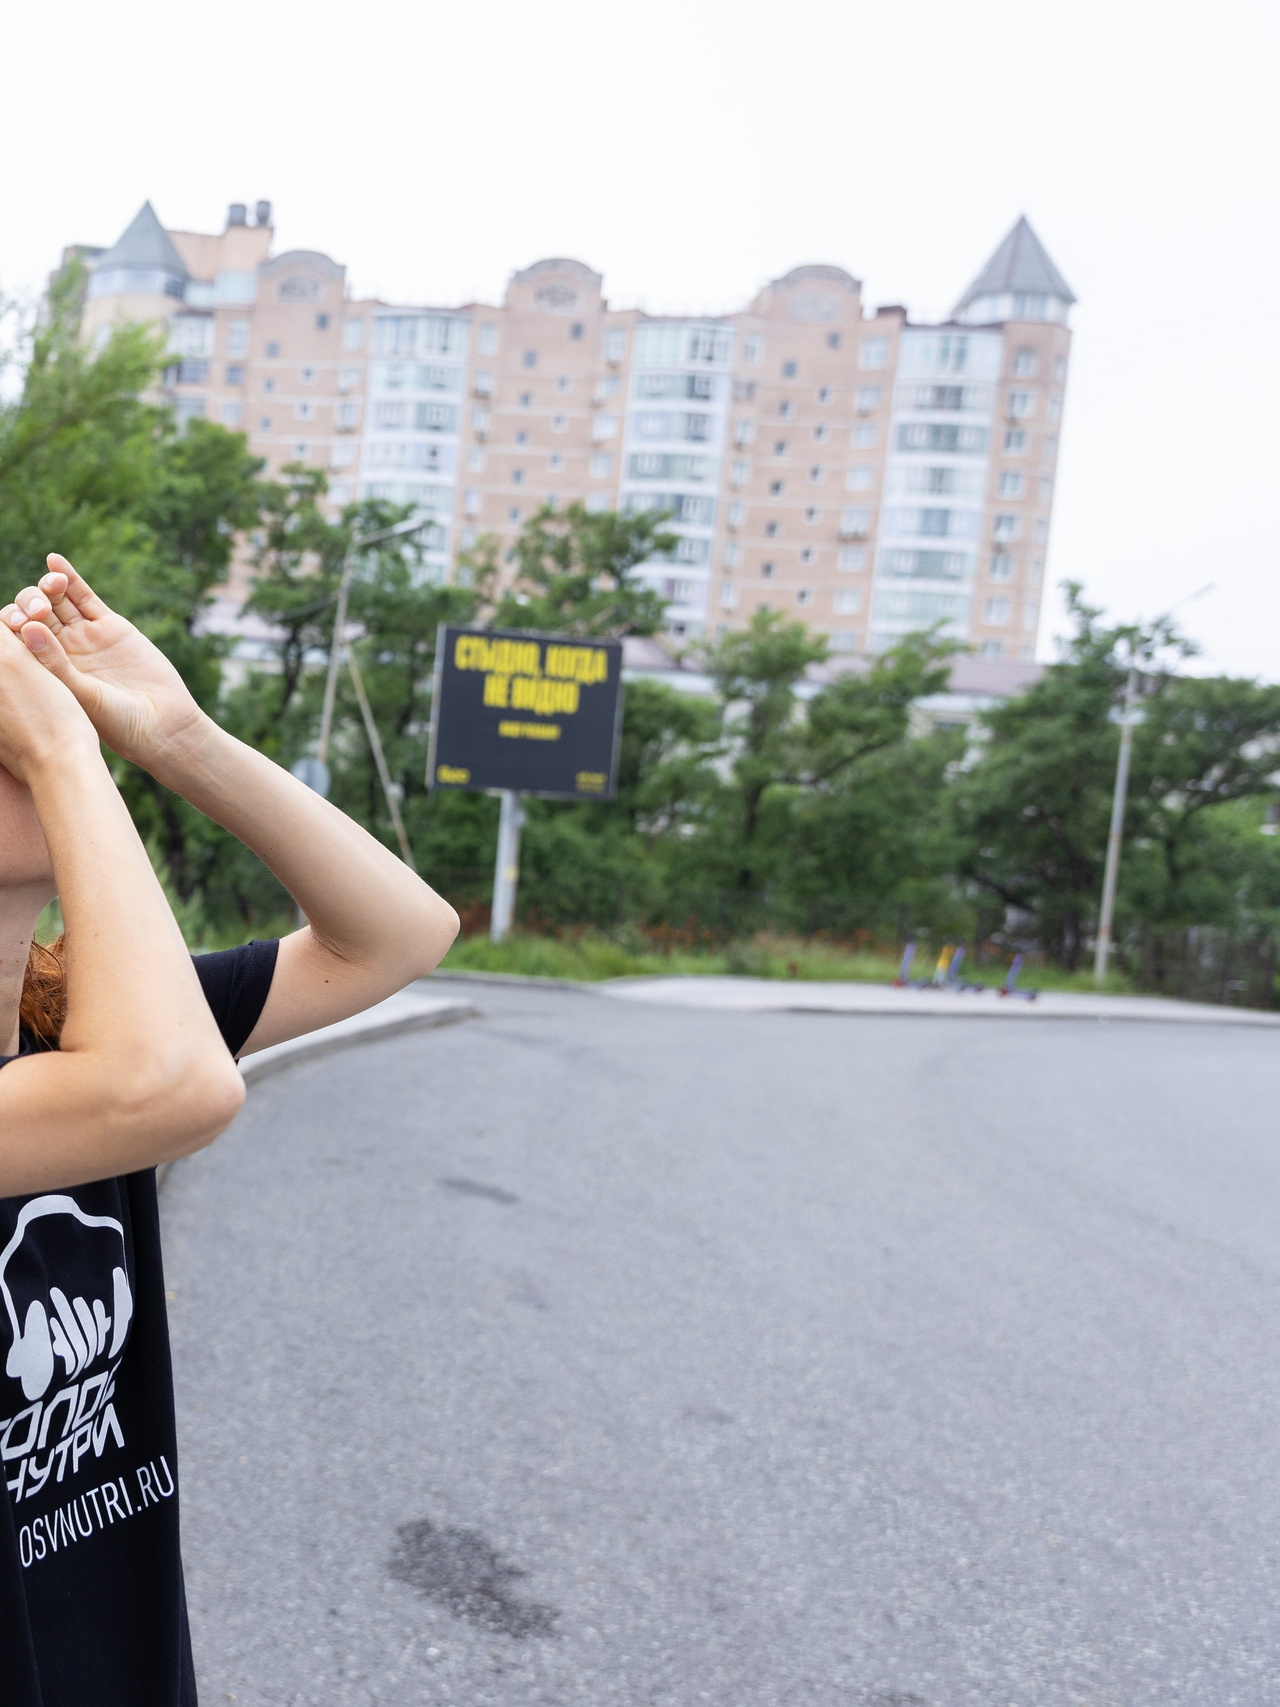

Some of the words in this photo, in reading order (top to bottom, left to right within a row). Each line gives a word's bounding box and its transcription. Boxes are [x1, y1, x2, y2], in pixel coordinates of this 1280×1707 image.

[455, 635, 542, 677] СТЫДНО,
[545, 645, 608, 685] КОГДА
[483, 673, 509, 708] НЕ
[510, 676, 580, 715] ВИДНО
[3, 1403, 125, 1503] НУТРИ
[19, 1455, 175, 1568] OSVNUTRI.RU
